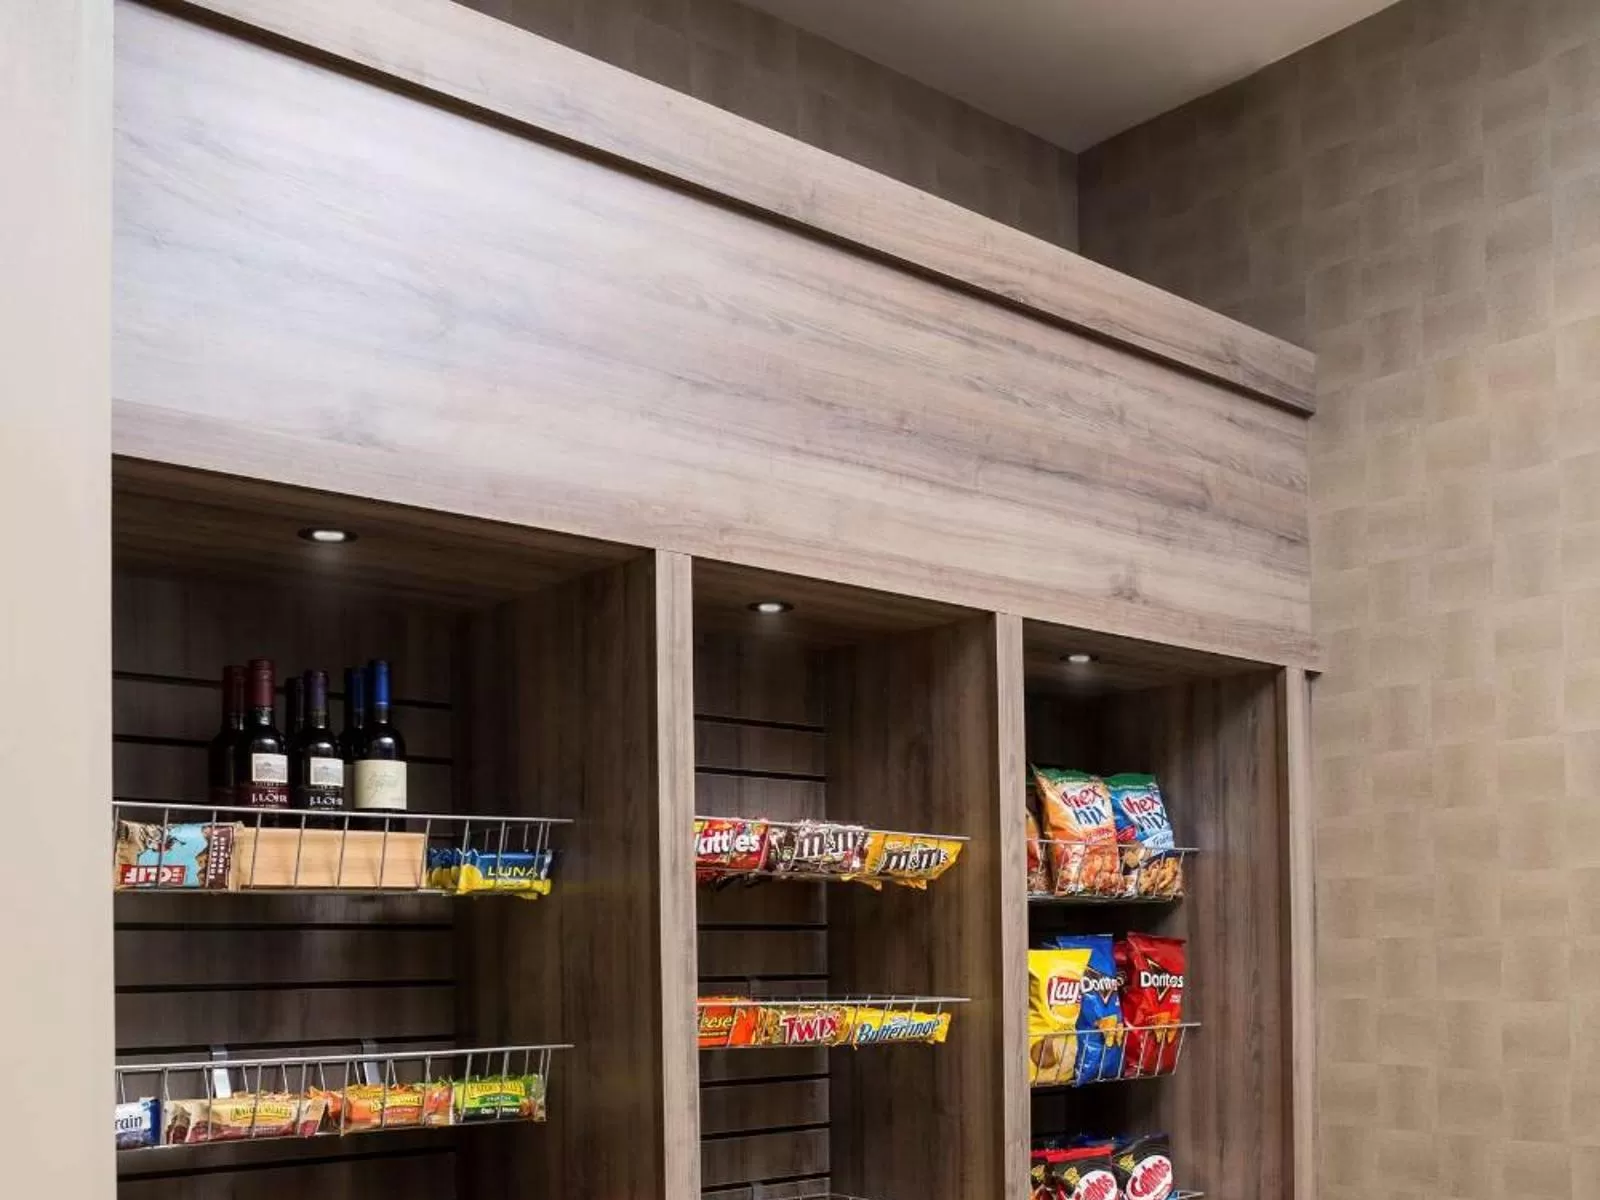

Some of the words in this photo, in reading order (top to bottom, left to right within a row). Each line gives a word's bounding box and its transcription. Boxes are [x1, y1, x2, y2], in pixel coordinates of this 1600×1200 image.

[694, 829, 761, 855] kittles
[487, 866, 538, 877] LUNA
[1140, 970, 1184, 988] Doritos
